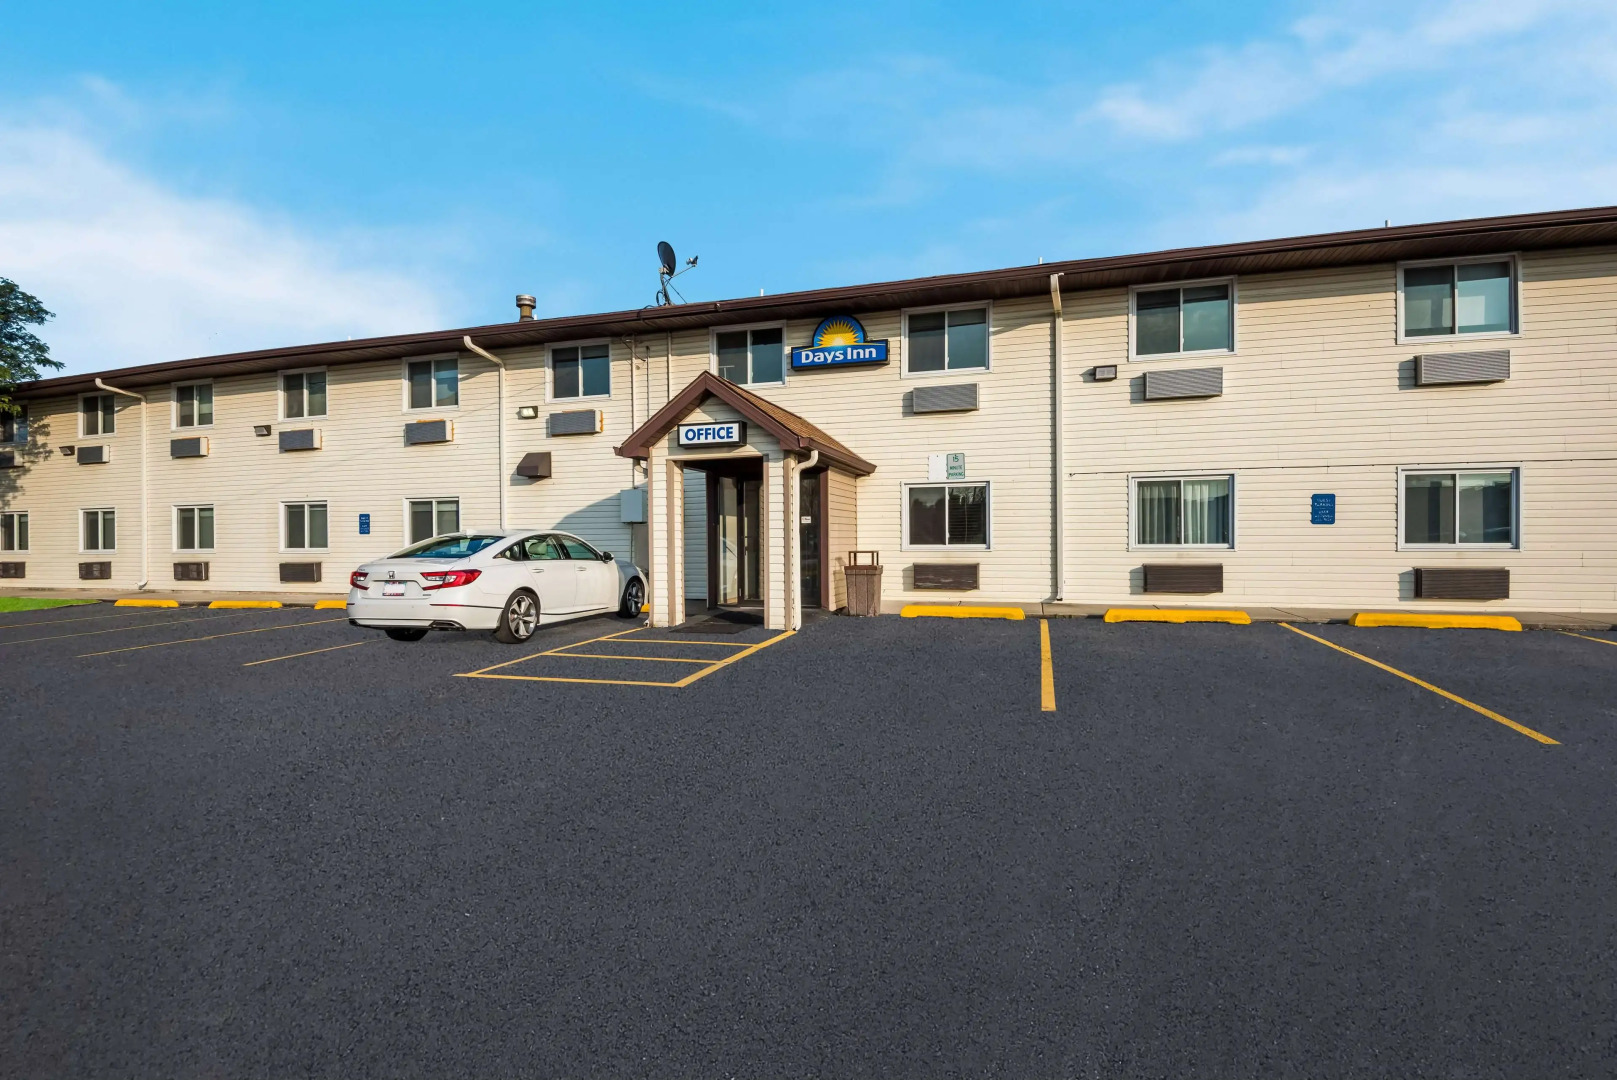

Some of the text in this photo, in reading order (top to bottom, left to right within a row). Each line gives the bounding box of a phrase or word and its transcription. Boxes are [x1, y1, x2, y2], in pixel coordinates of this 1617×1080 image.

[801, 347, 877, 363] Days Inn
[685, 426, 733, 441] OFFICE
